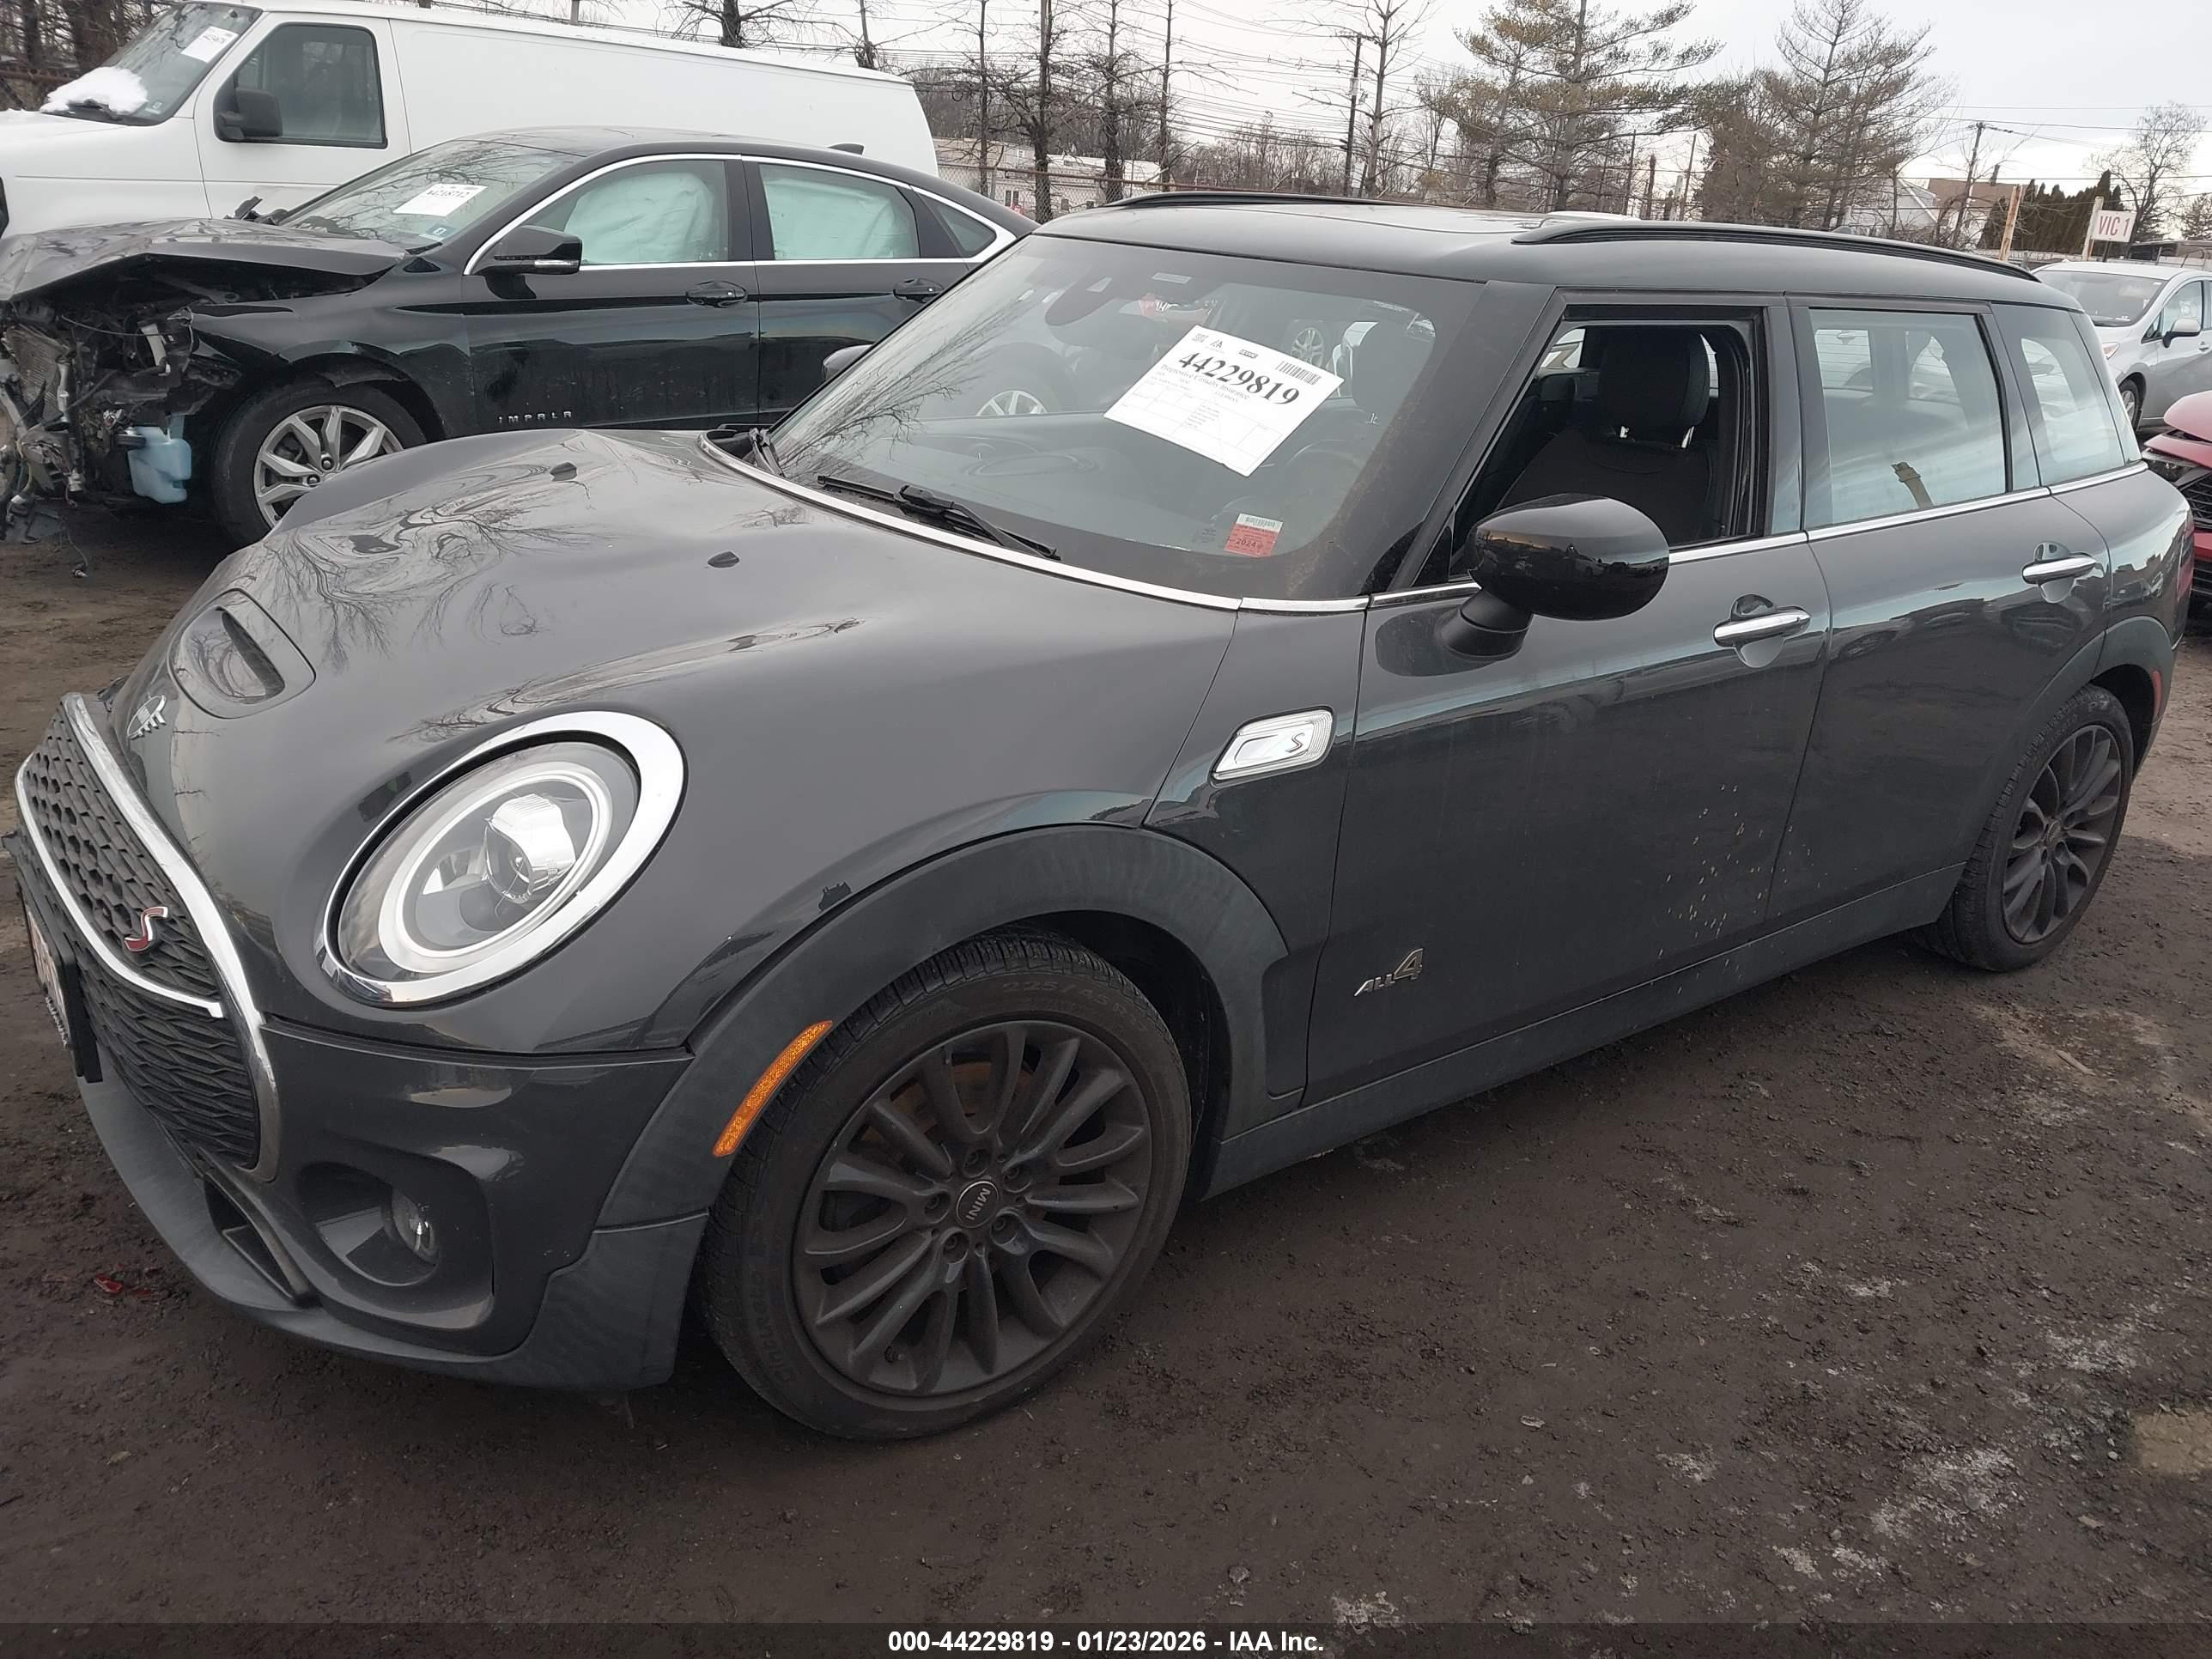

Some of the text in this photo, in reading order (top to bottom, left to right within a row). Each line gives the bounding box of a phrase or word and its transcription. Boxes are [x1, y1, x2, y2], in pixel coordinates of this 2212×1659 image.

[2099, 216, 2131, 237] VIC 1
[1178, 352, 1300, 404] 44229819
[1285, 732, 1304, 753] S
[124, 906, 169, 952] S
[965, 1188, 991, 1221] MINI
